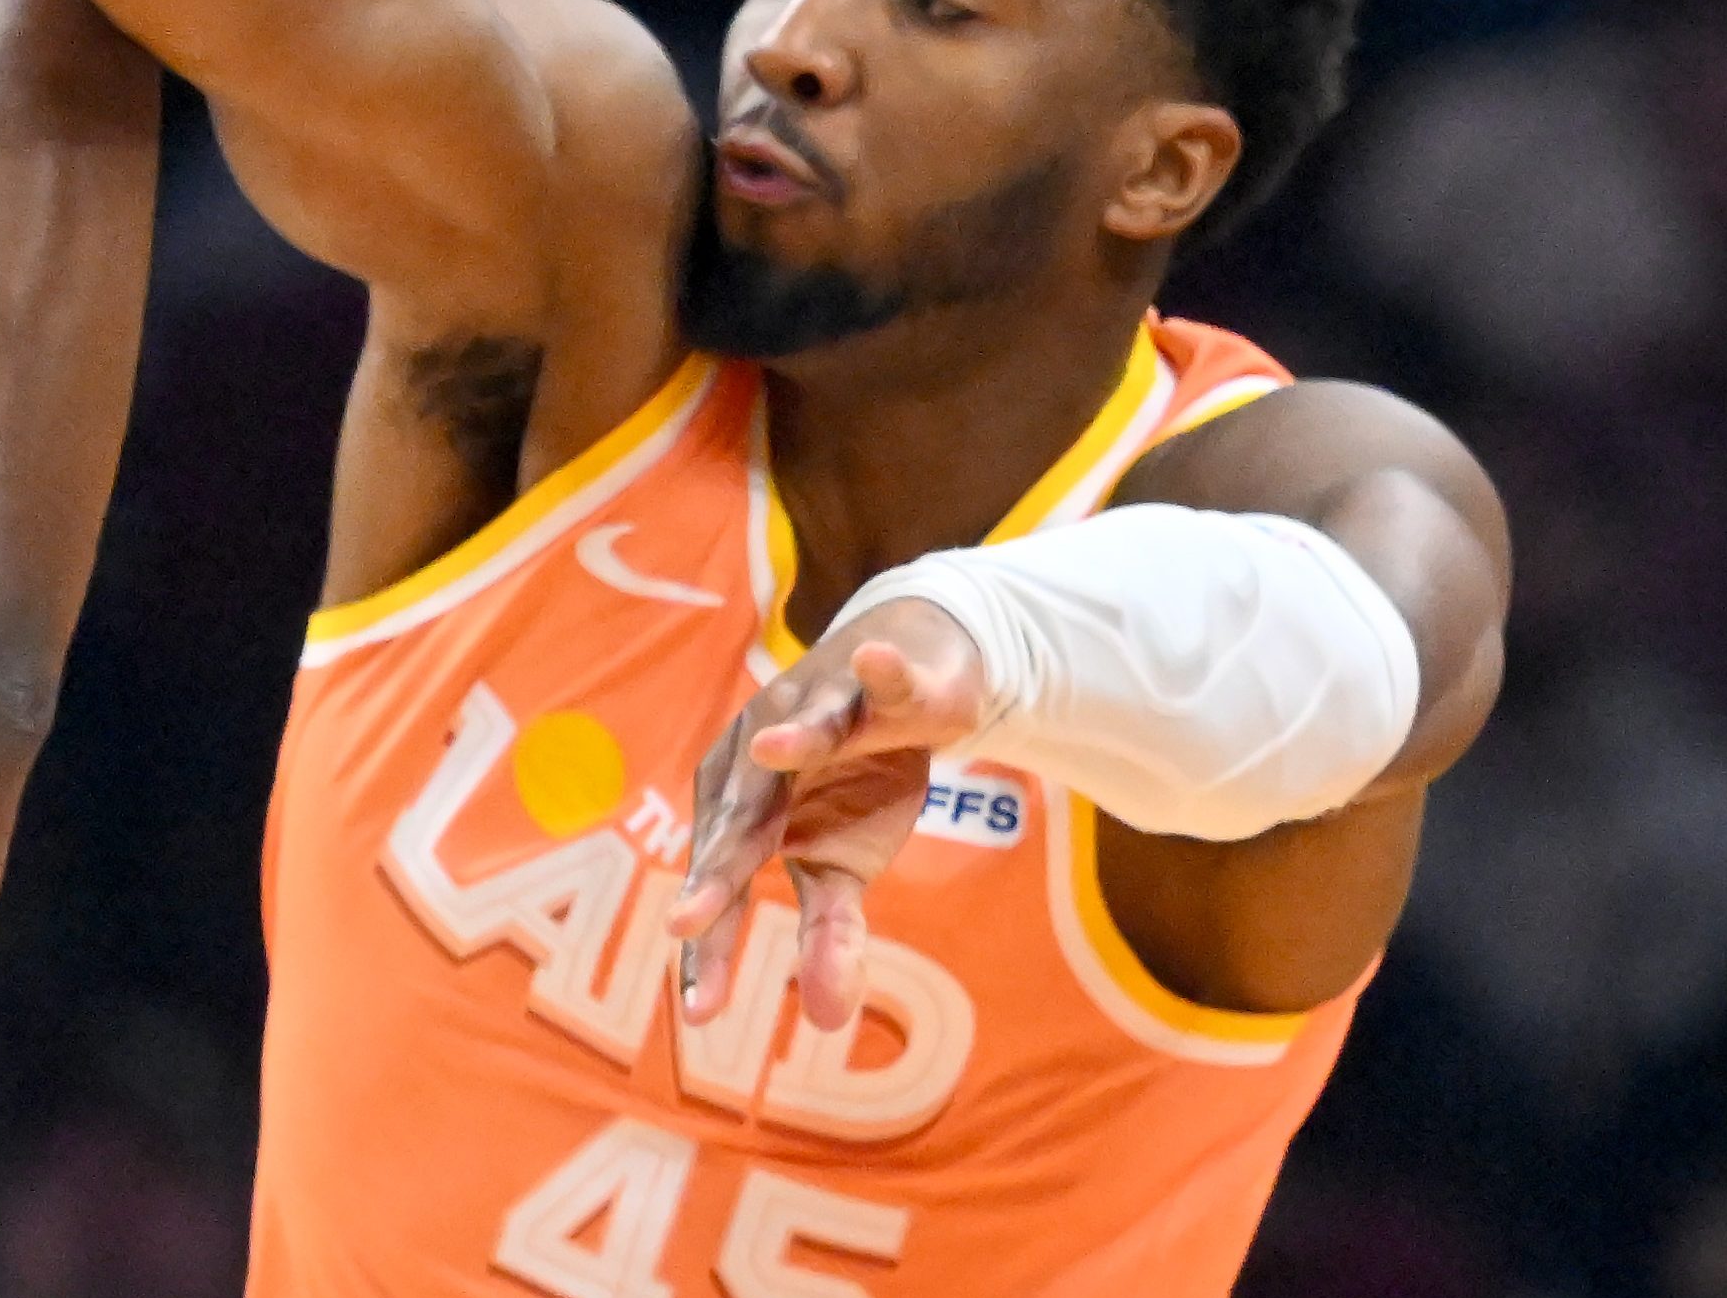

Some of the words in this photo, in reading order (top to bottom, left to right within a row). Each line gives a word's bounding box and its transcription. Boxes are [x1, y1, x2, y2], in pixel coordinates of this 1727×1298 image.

[625, 787, 694, 866] TH
[920, 783, 1019, 834] FFS
[376, 678, 977, 1143] LAND
